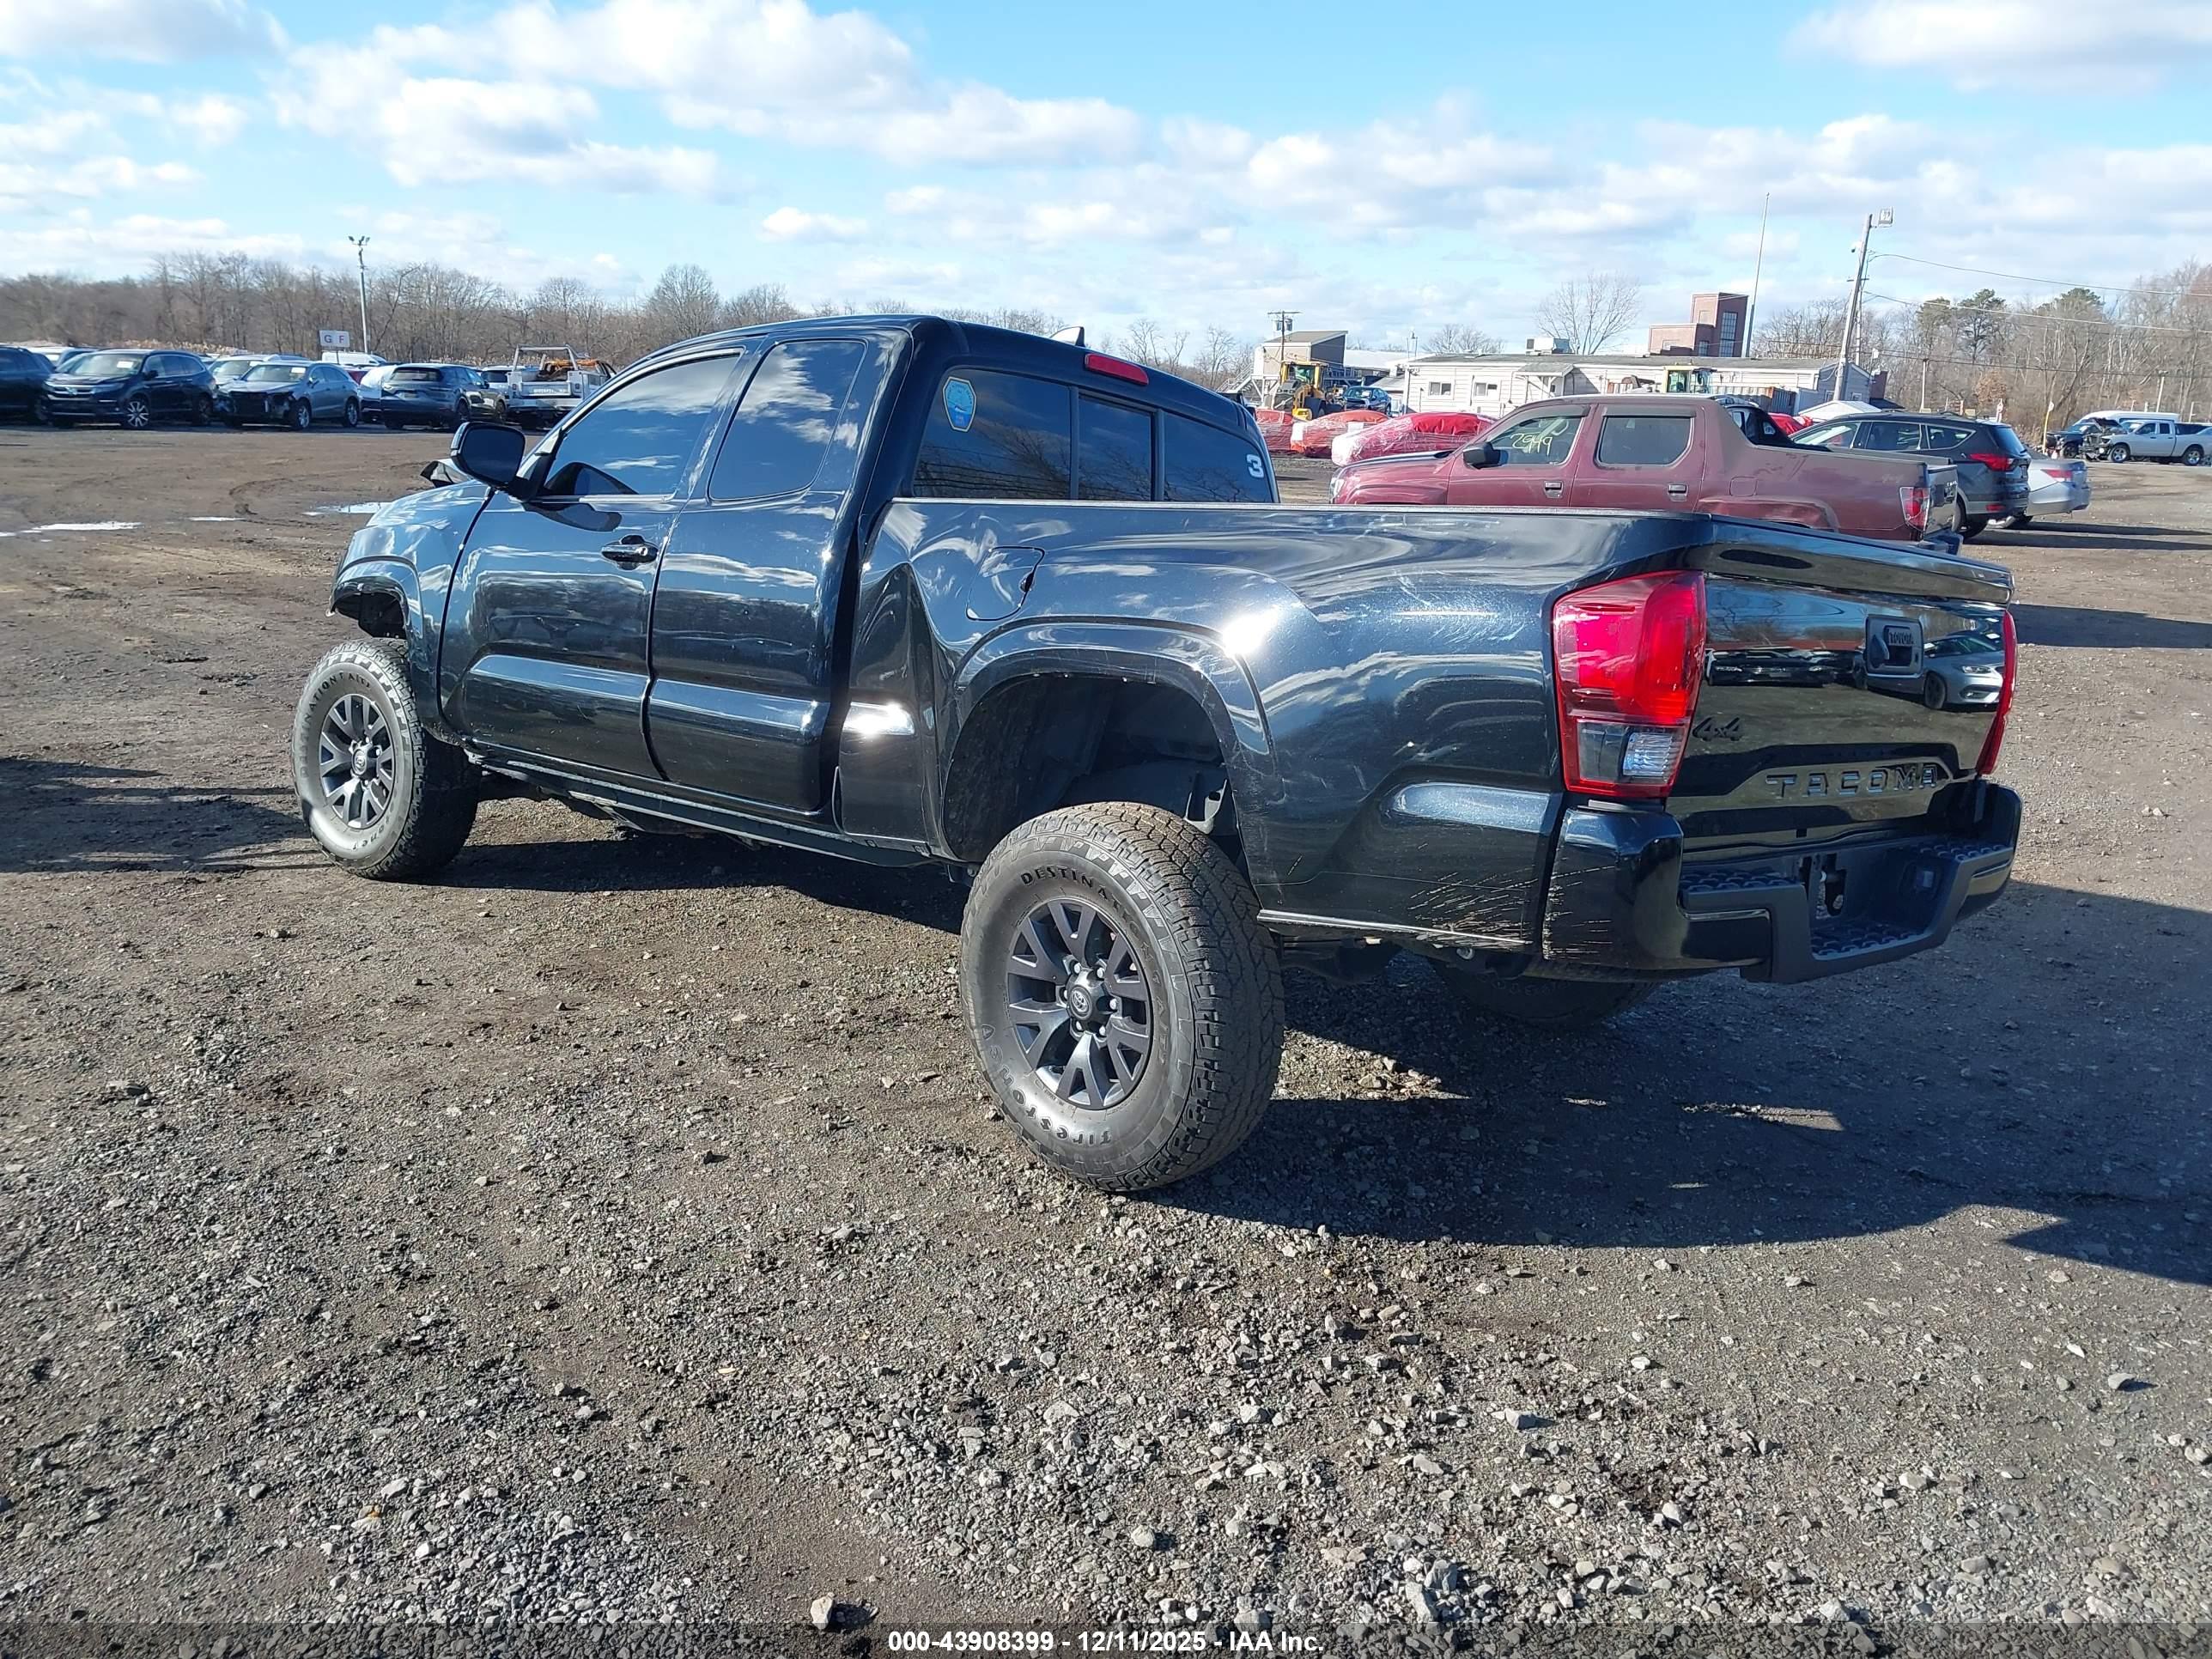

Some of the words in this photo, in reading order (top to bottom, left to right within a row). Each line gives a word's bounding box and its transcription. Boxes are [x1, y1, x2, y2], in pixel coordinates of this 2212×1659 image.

[324, 334, 332, 343] G
[1246, 453, 1264, 477] 3
[1765, 763, 1939, 800] TACOMA
